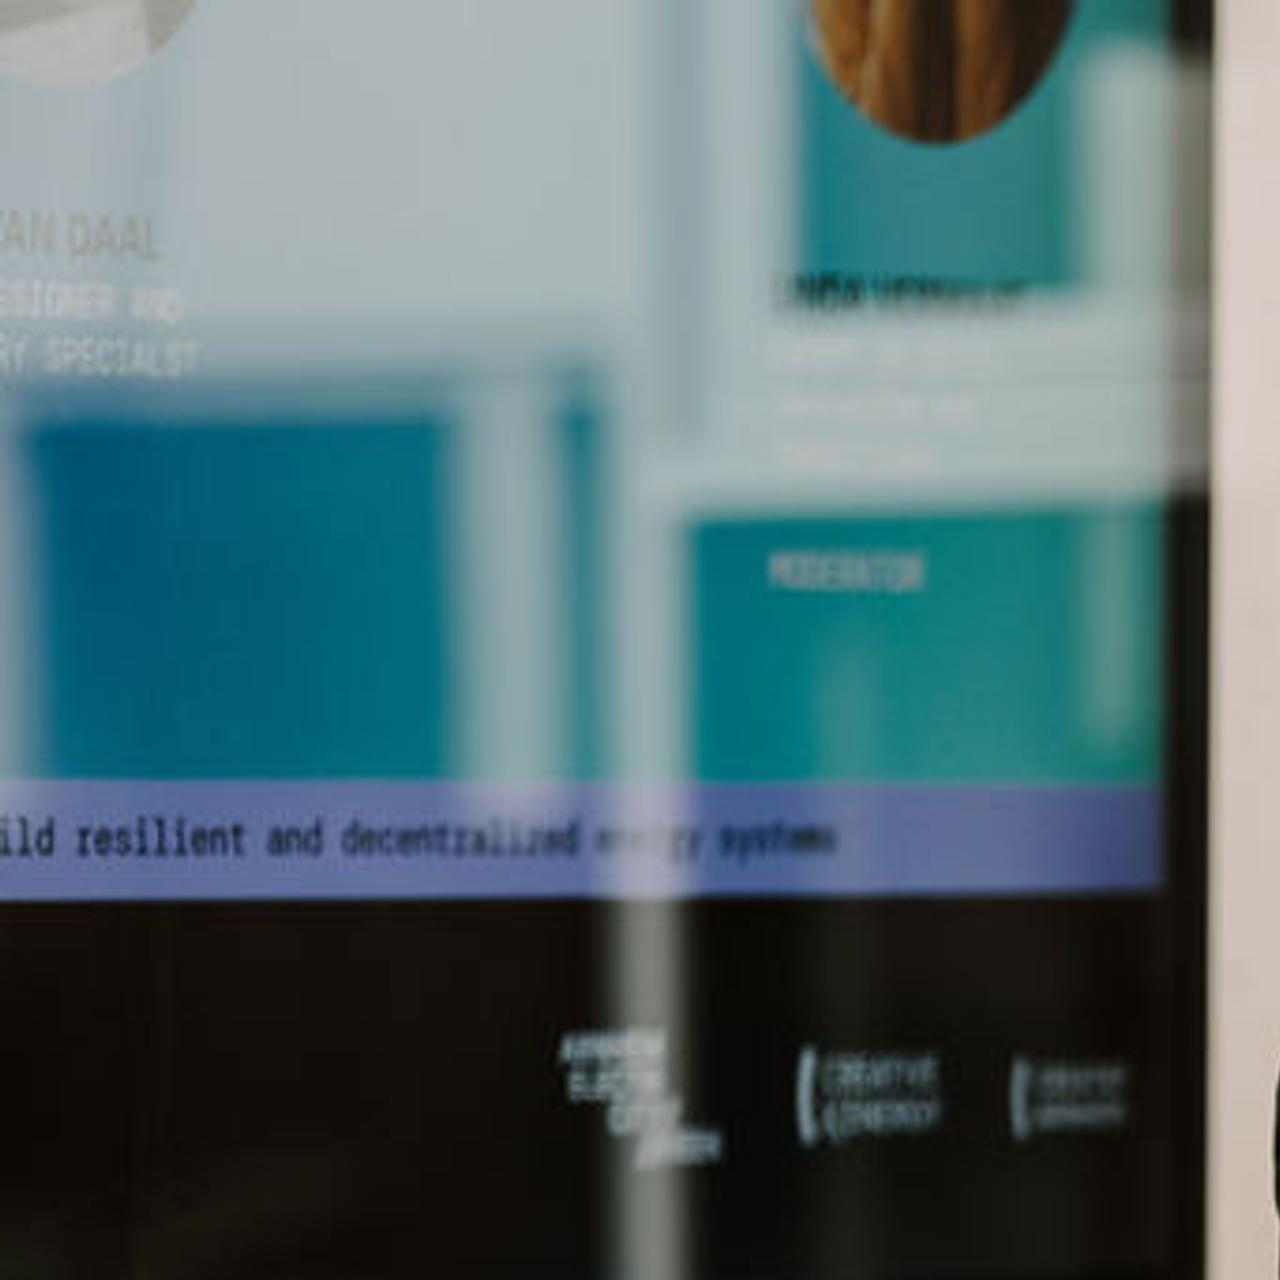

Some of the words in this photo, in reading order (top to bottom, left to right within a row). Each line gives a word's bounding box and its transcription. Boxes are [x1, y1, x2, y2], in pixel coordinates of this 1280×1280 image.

[0, 208, 56, 256] AN
[77, 816, 244, 856] resilient
[267, 816, 323, 856] and
[341, 819, 580, 857] decentralized
